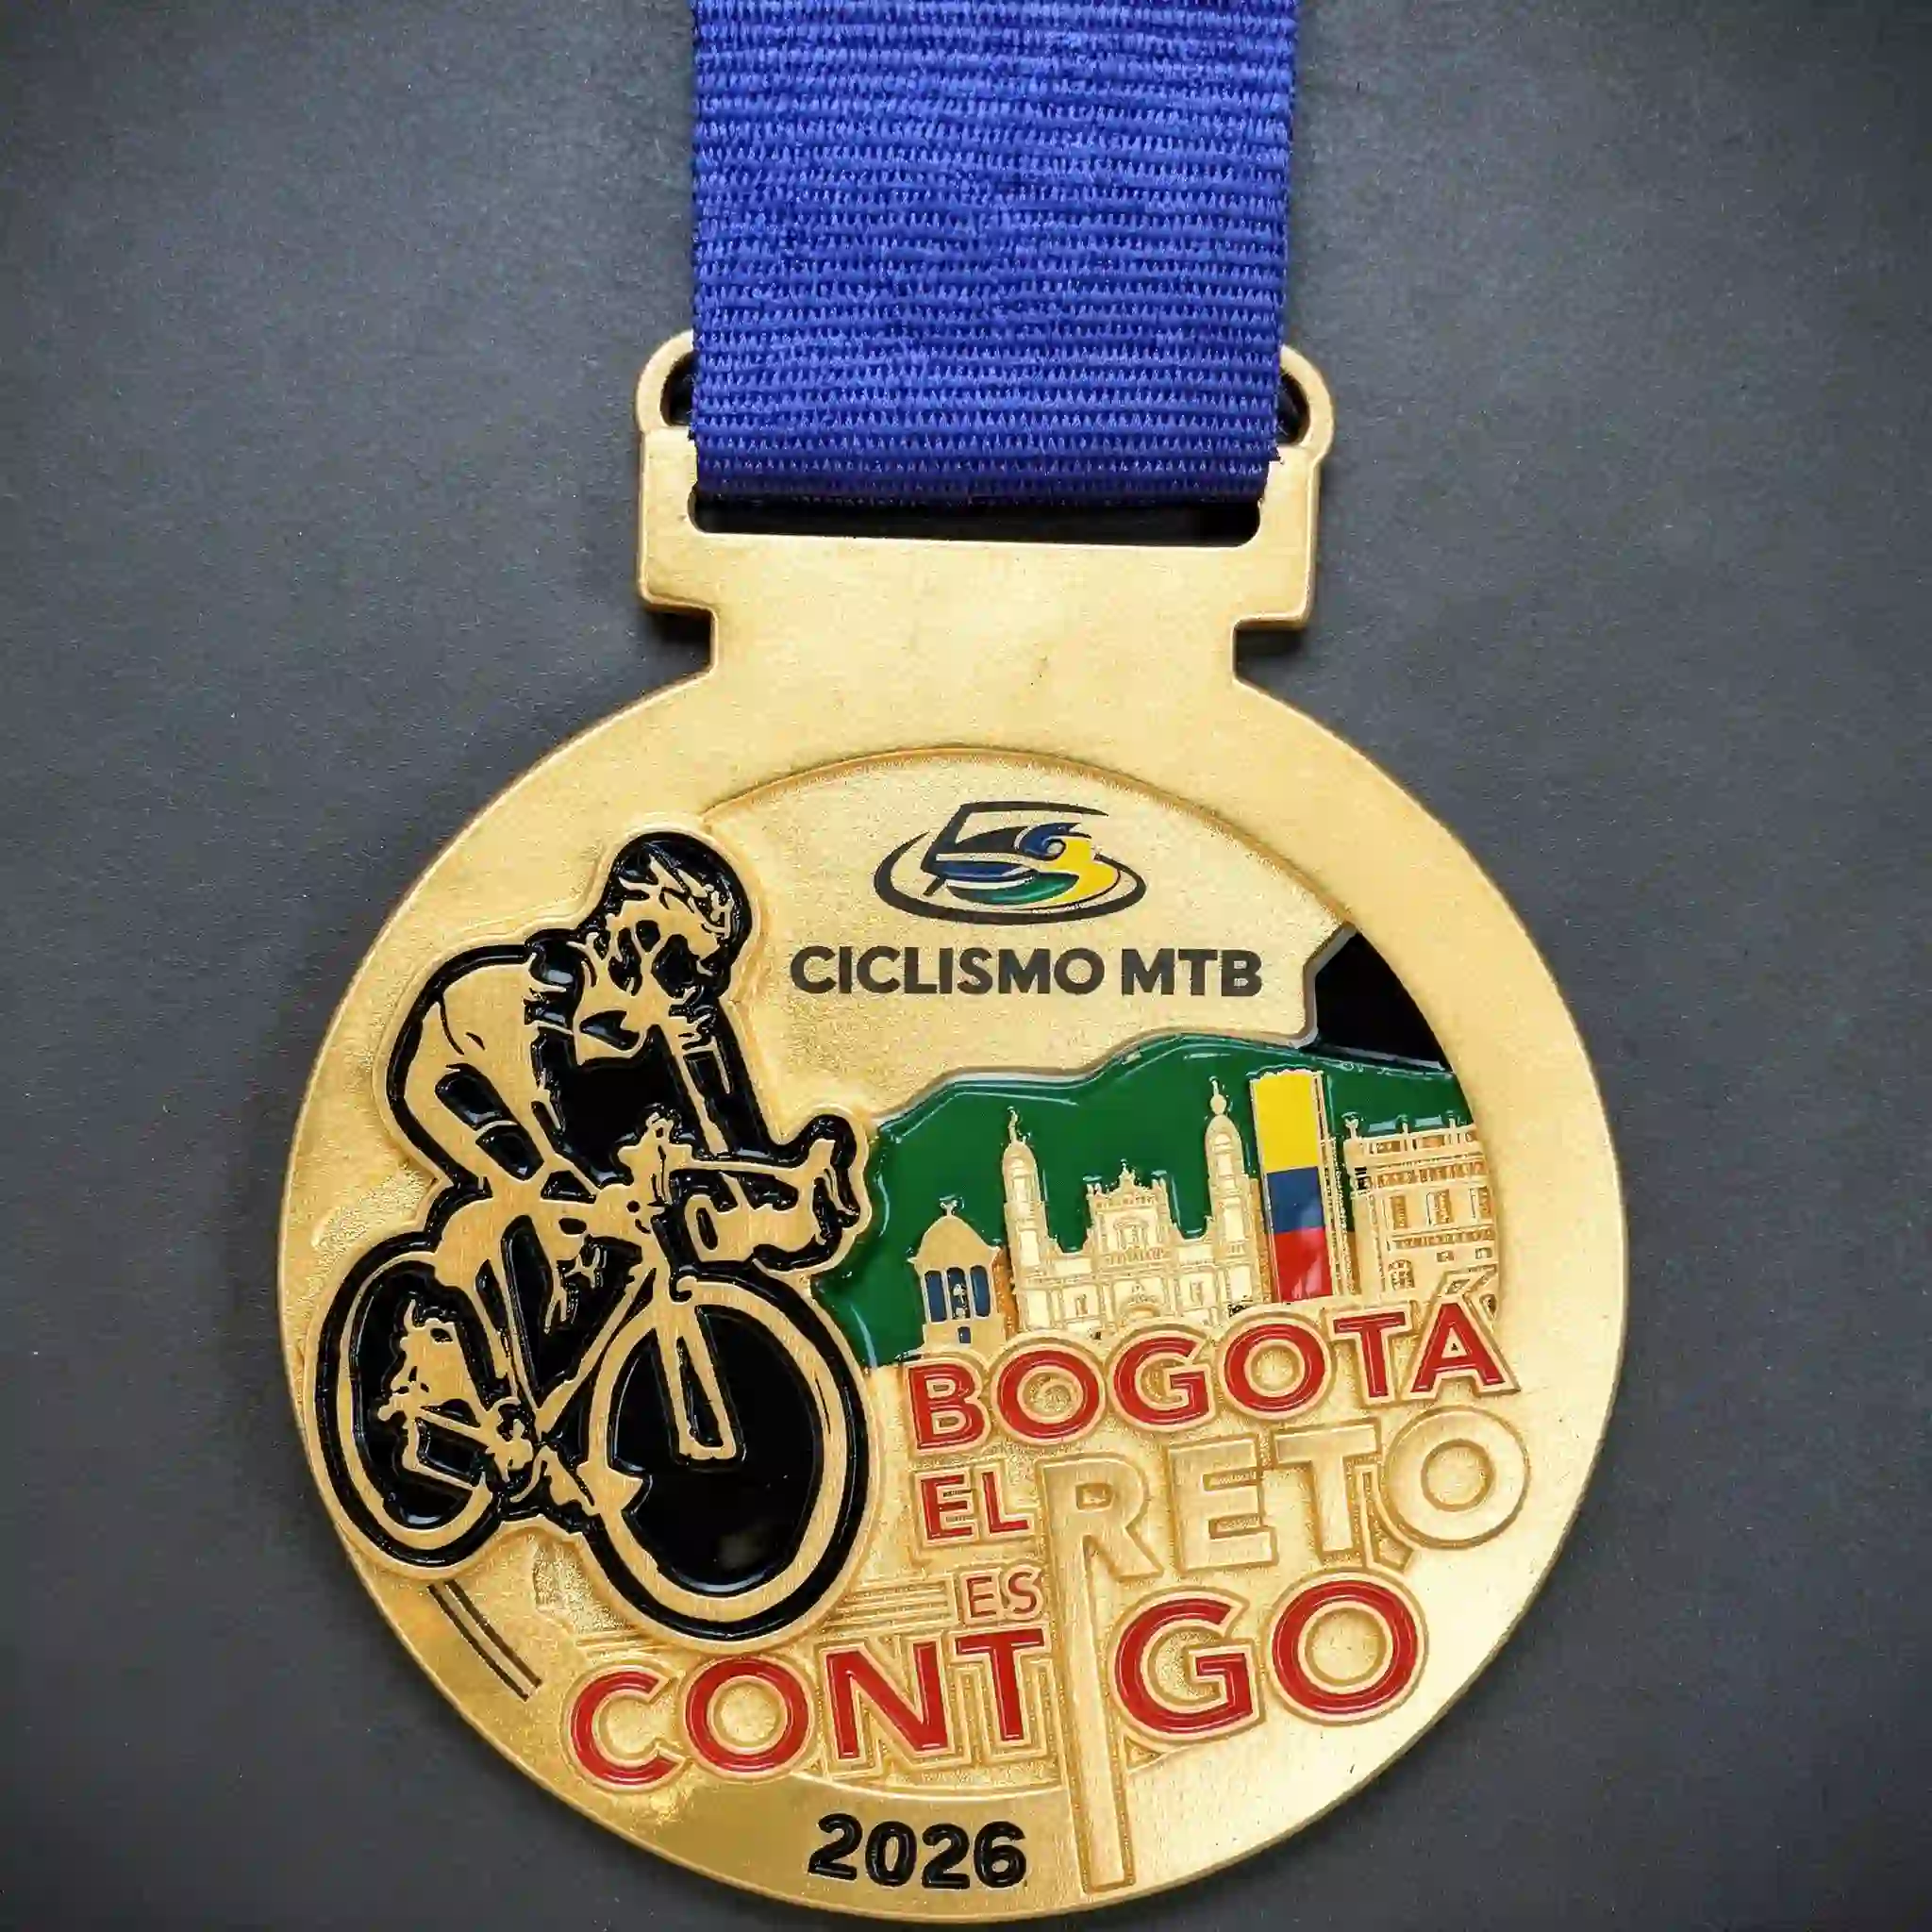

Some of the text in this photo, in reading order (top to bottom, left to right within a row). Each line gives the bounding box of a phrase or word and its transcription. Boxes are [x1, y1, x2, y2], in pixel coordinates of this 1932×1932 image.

[790, 945, 1262, 997] CICLISMO MTB
[920, 1406, 1530, 1583] EL RETO
[965, 1571, 1038, 1617] ES
[808, 1813, 1027, 1890] 2026
